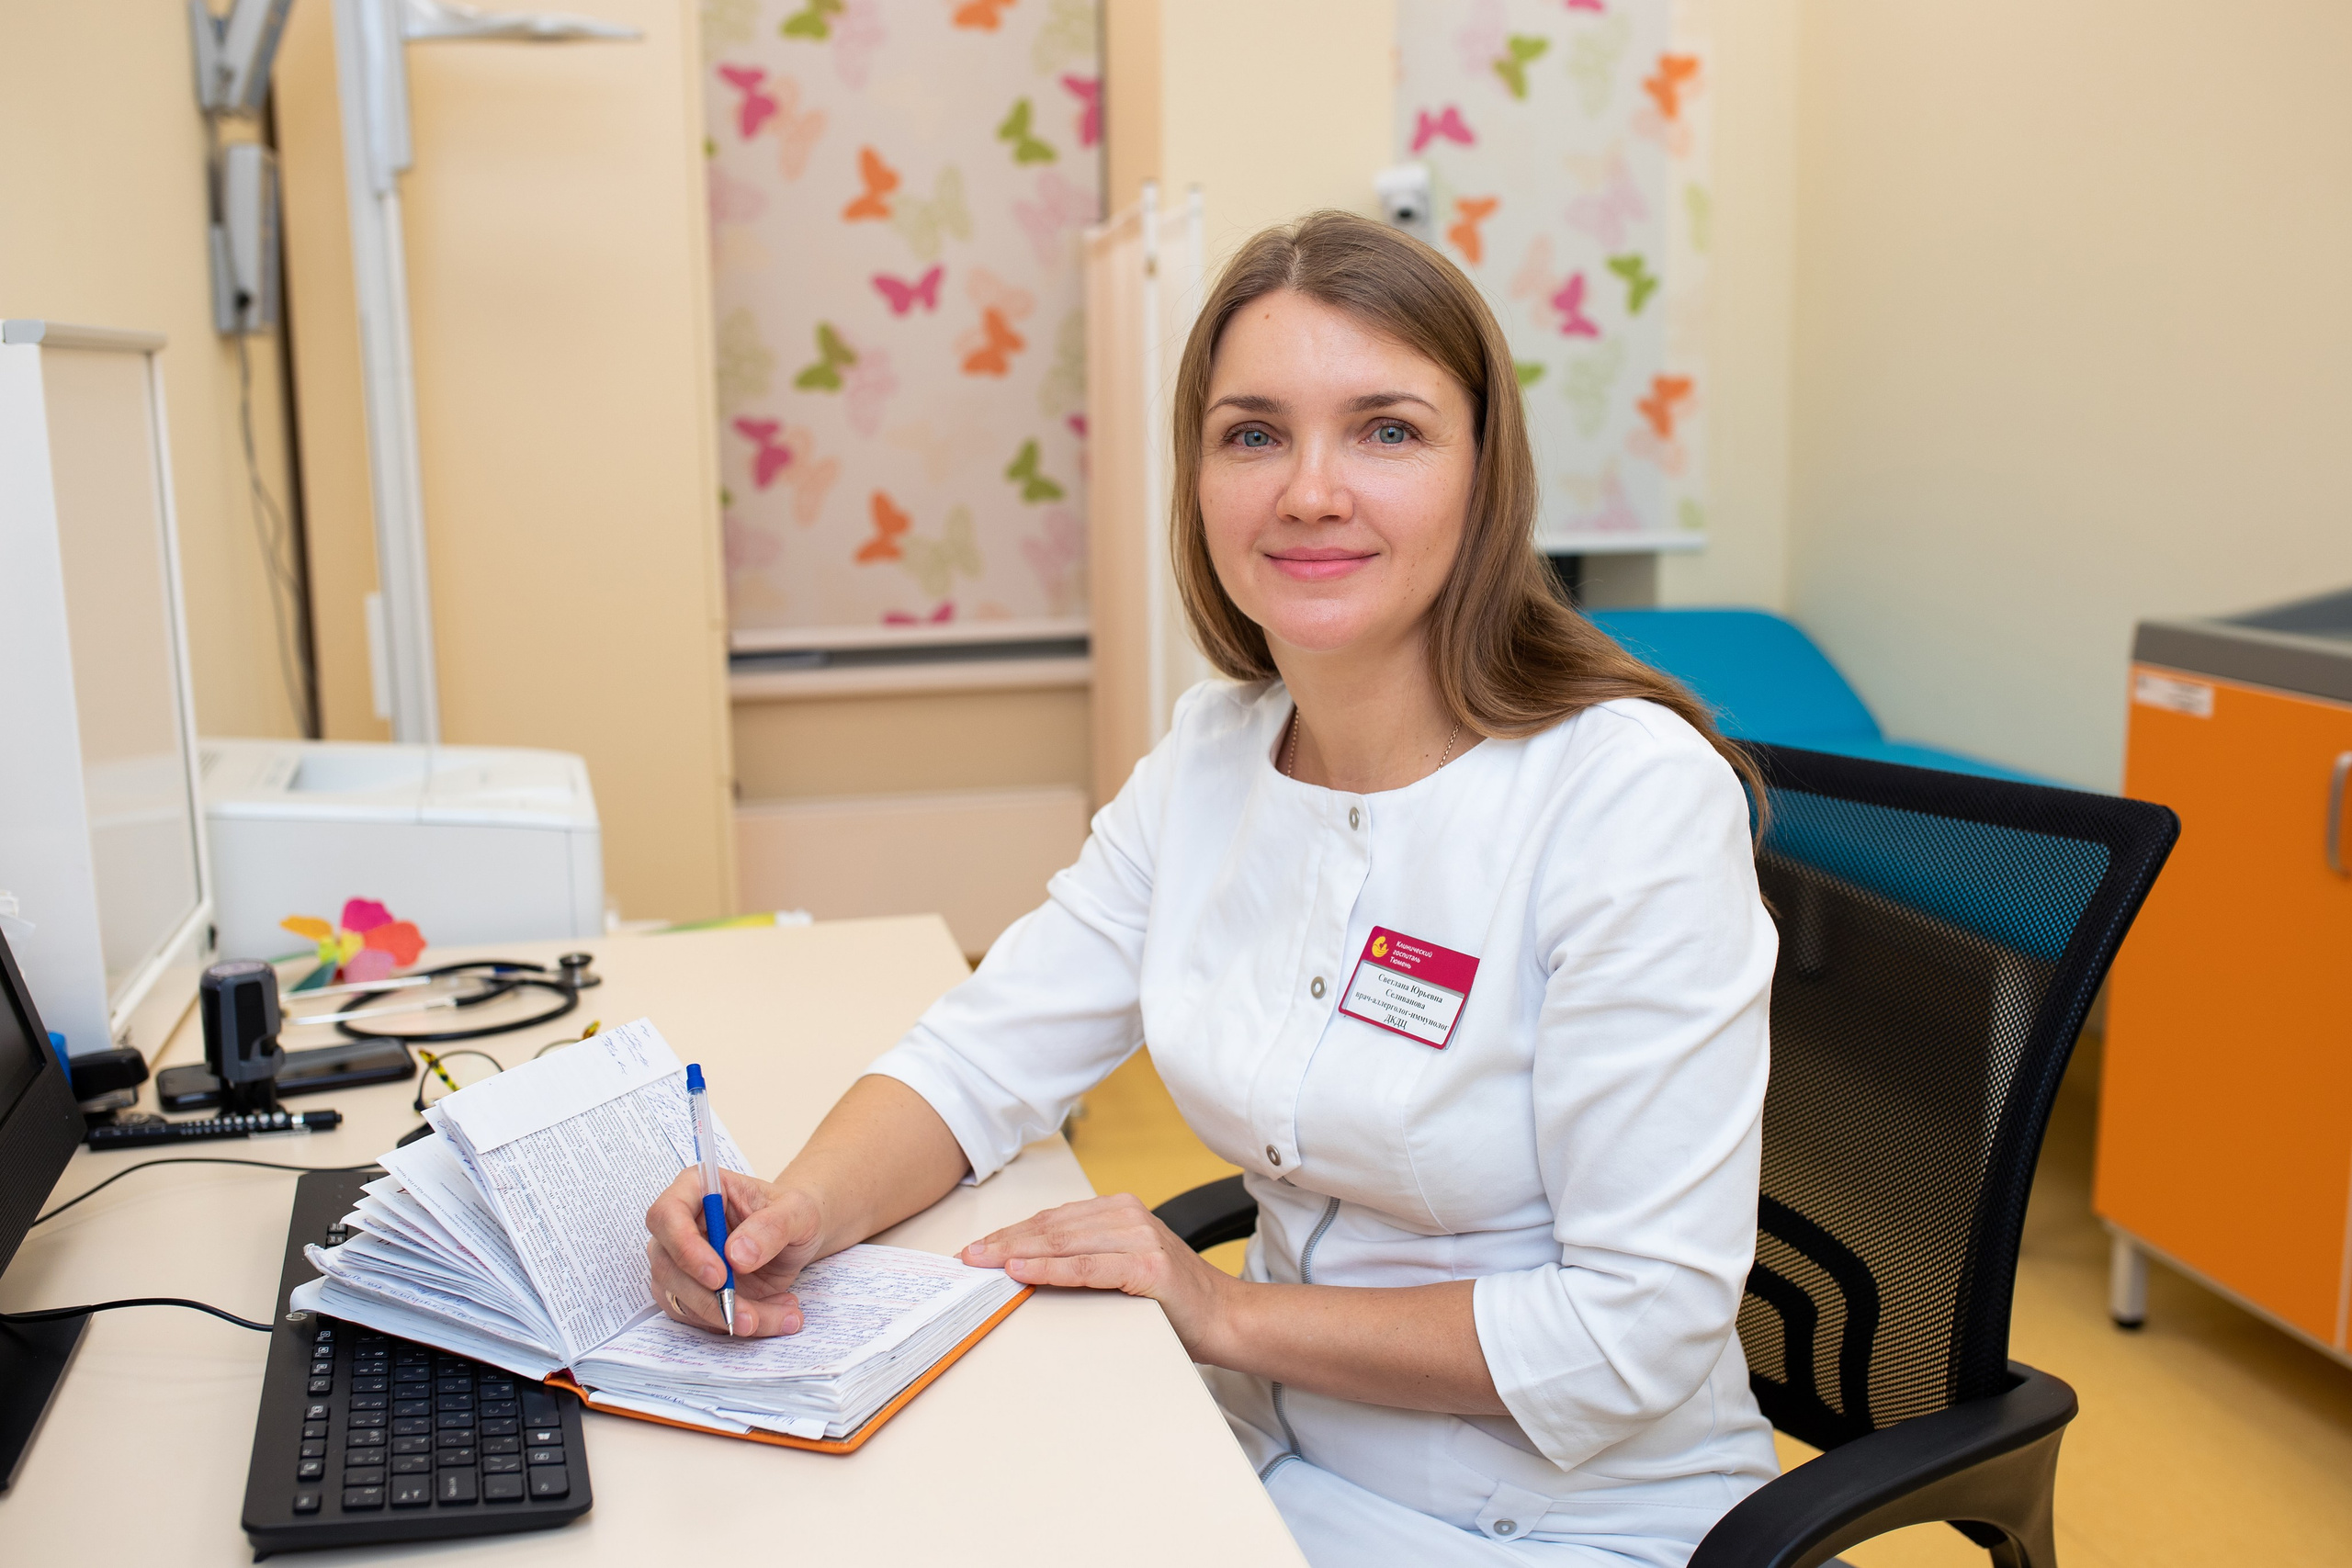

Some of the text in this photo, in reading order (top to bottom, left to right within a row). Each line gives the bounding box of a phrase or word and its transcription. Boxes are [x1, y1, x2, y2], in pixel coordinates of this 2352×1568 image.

[1393, 950, 1420, 963] госпиталь
[1396, 941, 1432, 958] Клинический
[1390, 956, 1412, 969] Тюмень
[1378, 973, 1443, 1003] Светлана Юрьевна
[1385, 988, 1425, 1010] Селиванова
[1355, 991, 1449, 1031] врач-аллерголог-иммунолог
[1384, 1014, 1408, 1030] ДКДЦ
